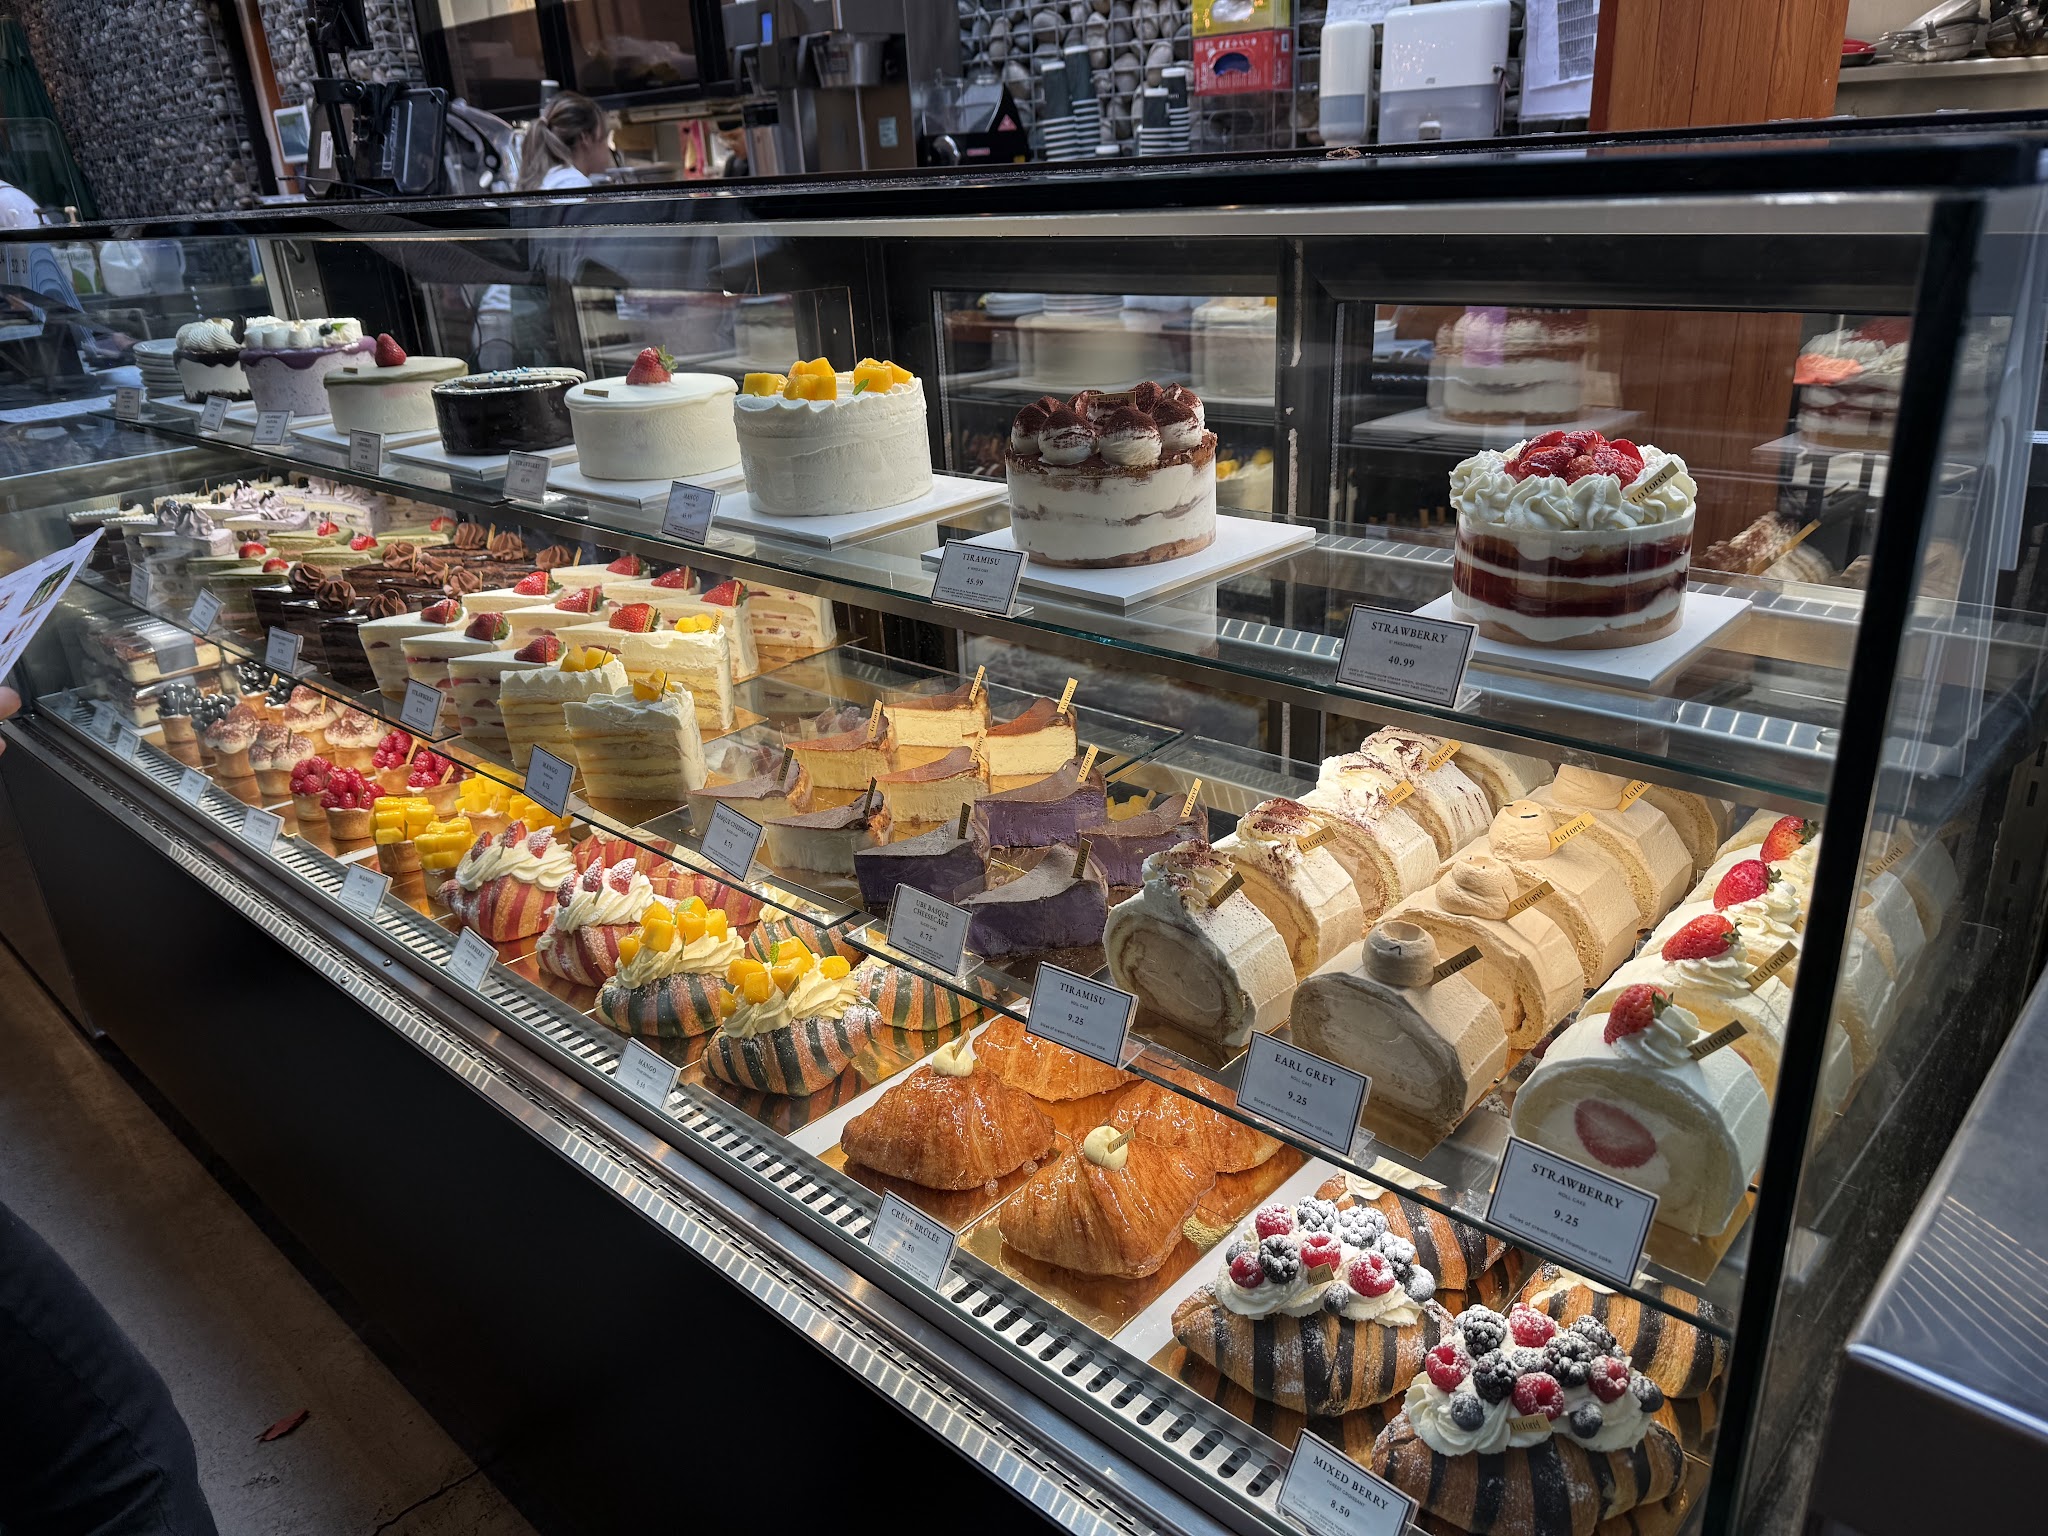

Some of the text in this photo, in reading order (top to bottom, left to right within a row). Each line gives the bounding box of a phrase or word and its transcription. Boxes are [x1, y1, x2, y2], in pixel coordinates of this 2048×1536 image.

[962, 552, 1001, 566] TIRAMISU
[966, 577, 984, 587] 45.99
[1371, 621, 1449, 644] STRAWBERRY
[1388, 655, 1415, 668] 40.99
[913, 907, 949, 929] CHEESECAKE
[915, 899, 950, 920] UBE BASQUE
[919, 930, 933, 942] 8.75
[1060, 981, 1107, 1006] TIRAMISU
[1067, 1012, 1085, 1026] 9.25
[637, 1058, 657, 1074] MANGO
[1274, 1053, 1337, 1087] EARL GREY
[1290, 1074, 1312, 1088] ROLL CAKE
[1287, 1090, 1308, 1106] 9.25
[1530, 1163, 1625, 1210] STRAWBERRY
[1557, 1190, 1587, 1208] ROLL CAKE
[891, 1207, 941, 1245] CRÈME BRÛLÉE
[1553, 1208, 1580, 1228] 9.25
[1508, 1212, 1525, 1225] Slices
[1524, 1219, 1532, 1228] of
[1565, 1238, 1588, 1254] Tiramisu
[901, 1240, 915, 1254] 8.50
[1313, 1455, 1389, 1511] MIXED BERRY
[1326, 1479, 1366, 1508] FOREST CROISSANT
[1330, 1499, 1351, 1518] 8.50
